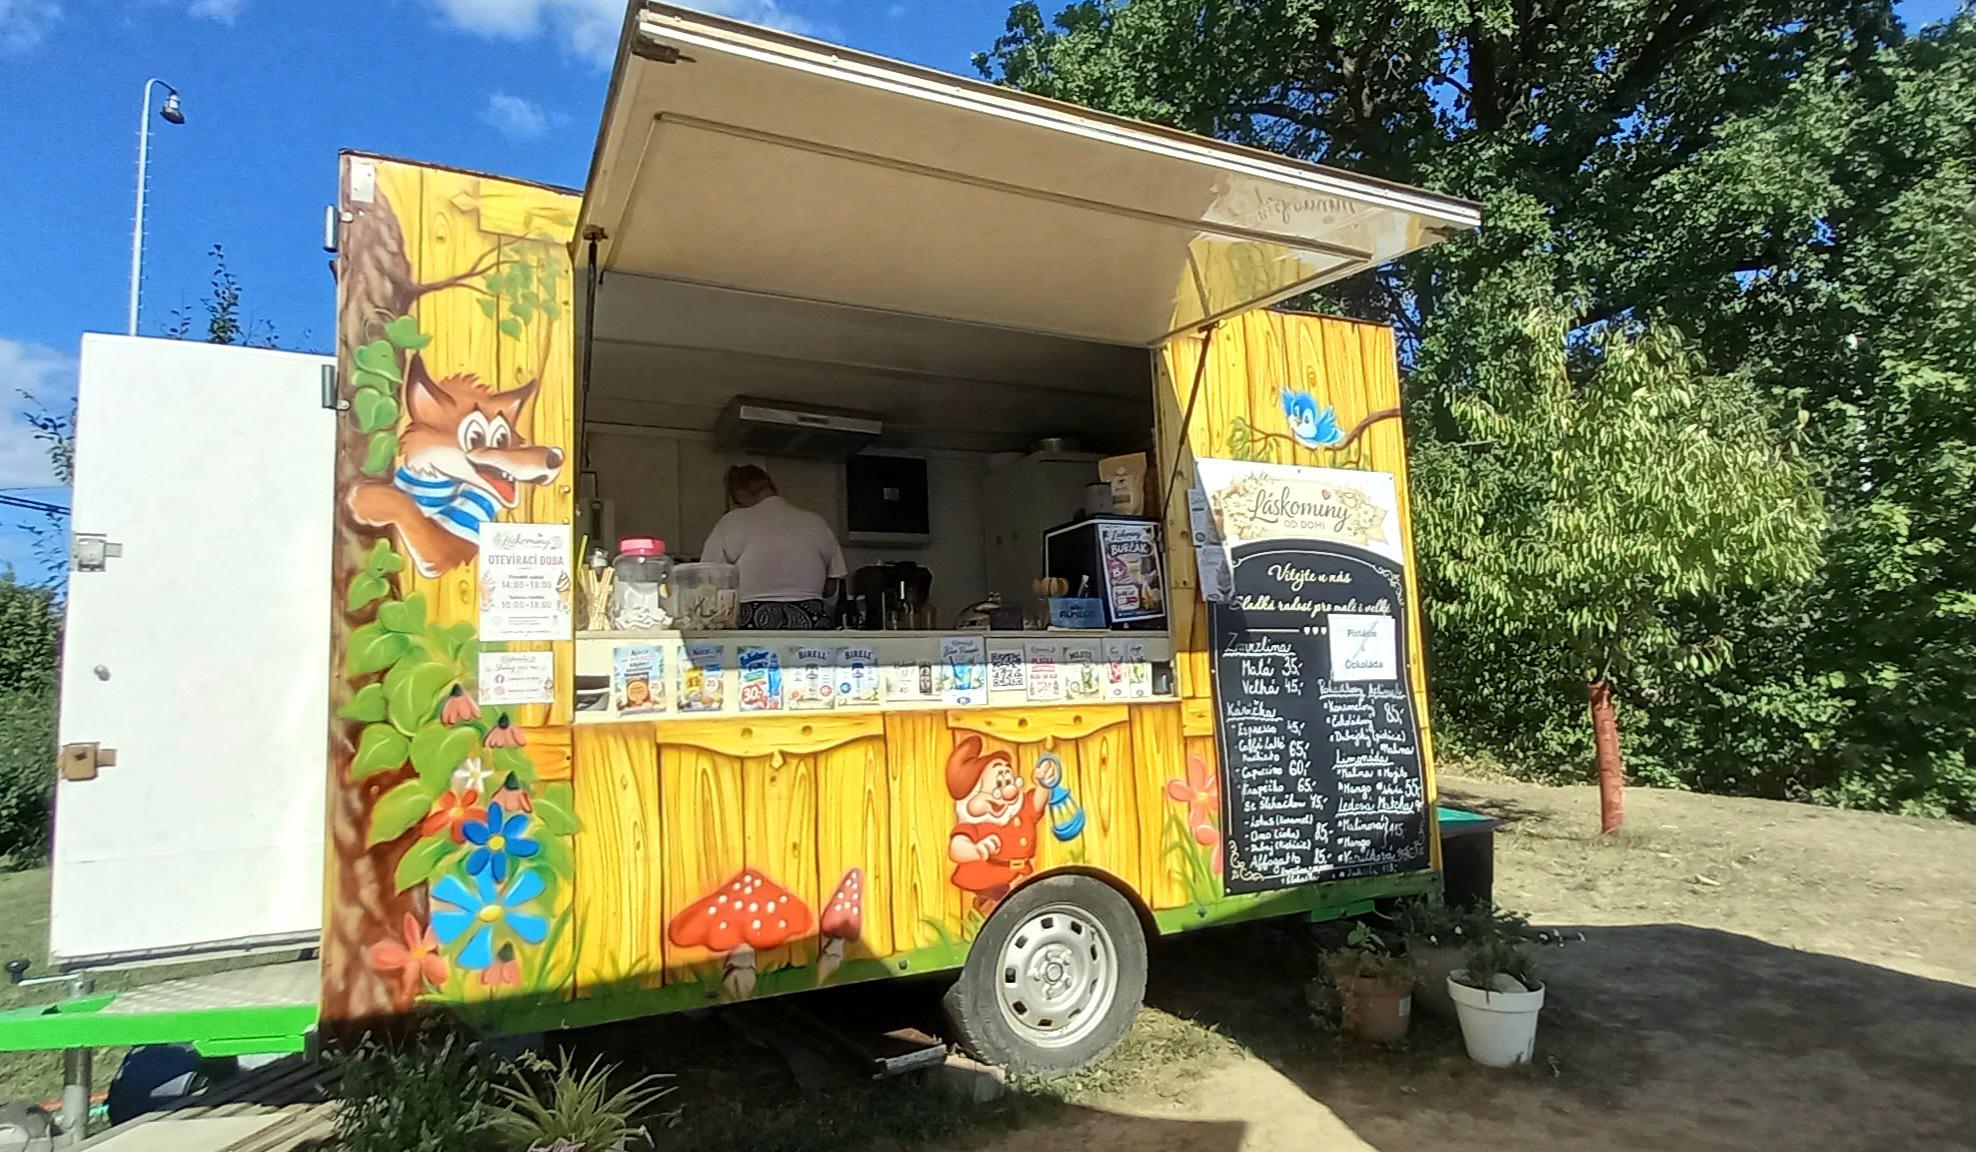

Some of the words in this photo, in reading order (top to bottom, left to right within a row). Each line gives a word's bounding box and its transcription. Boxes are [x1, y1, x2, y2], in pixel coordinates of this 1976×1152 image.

[1249, 487, 1353, 532] Láskominy
[1284, 520, 1298, 529] OD
[488, 553, 537, 566] OTEVÍRACÍ
[540, 554, 564, 566] DOBA
[1318, 573, 1327, 582] u
[1329, 569, 1352, 583] nás
[1278, 596, 1313, 611] radost
[1311, 601, 1332, 618] pro
[1358, 601, 1363, 612] i
[798, 650, 828, 660] BIRELL
[845, 650, 874, 660] BIRELL
[1242, 657, 1275, 676] Malá
[1242, 679, 1279, 695] Velká
[1344, 783, 1372, 800] Mango
[1377, 795, 1414, 811] Matcha
[1343, 814, 1386, 831] Malinová
[1344, 836, 1371, 853] Mango
